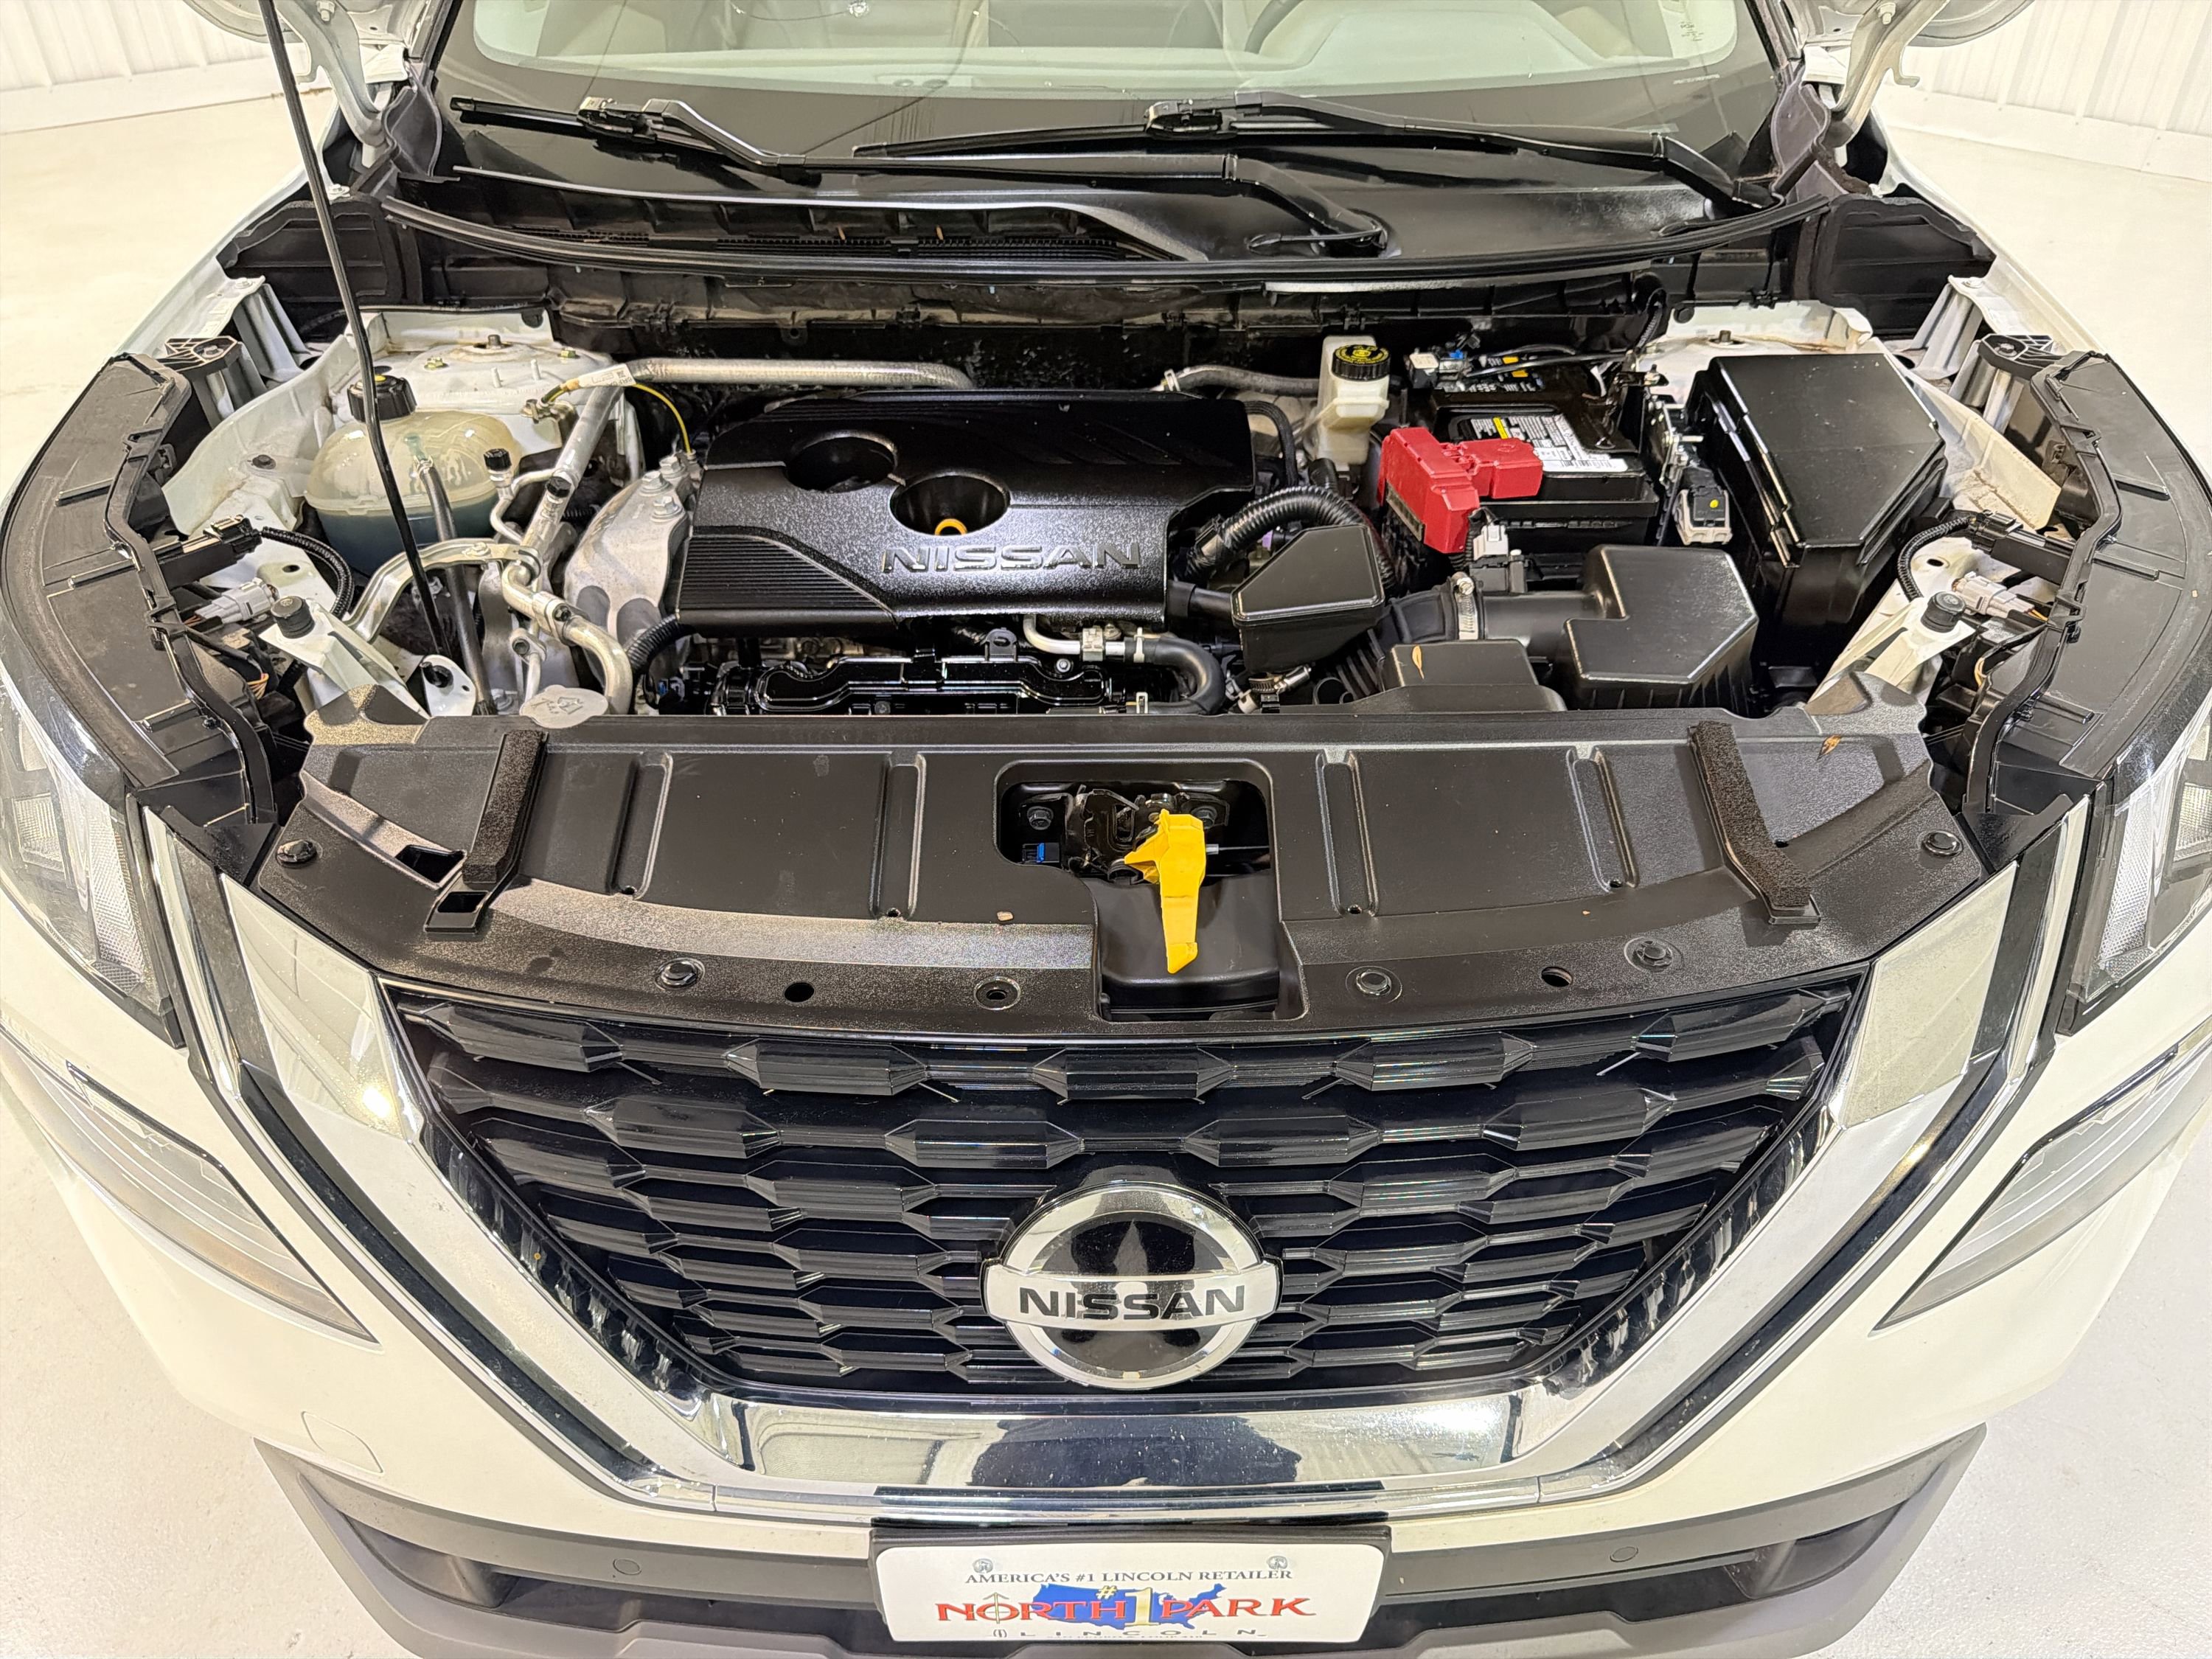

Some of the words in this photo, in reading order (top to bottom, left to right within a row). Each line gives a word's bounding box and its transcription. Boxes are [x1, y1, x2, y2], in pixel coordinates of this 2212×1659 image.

[881, 544, 1141, 572] NISSAN
[1019, 1285, 1245, 1320] NISSAN
[966, 1573, 1070, 1583] AMERICA'S
[1076, 1573, 1096, 1582] #1
[1102, 1572, 1193, 1582] LINCOLN
[1199, 1570, 1293, 1580] RETAILER
[935, 1600, 1127, 1621] NORTH
[1162, 1598, 1316, 1618] PARK
